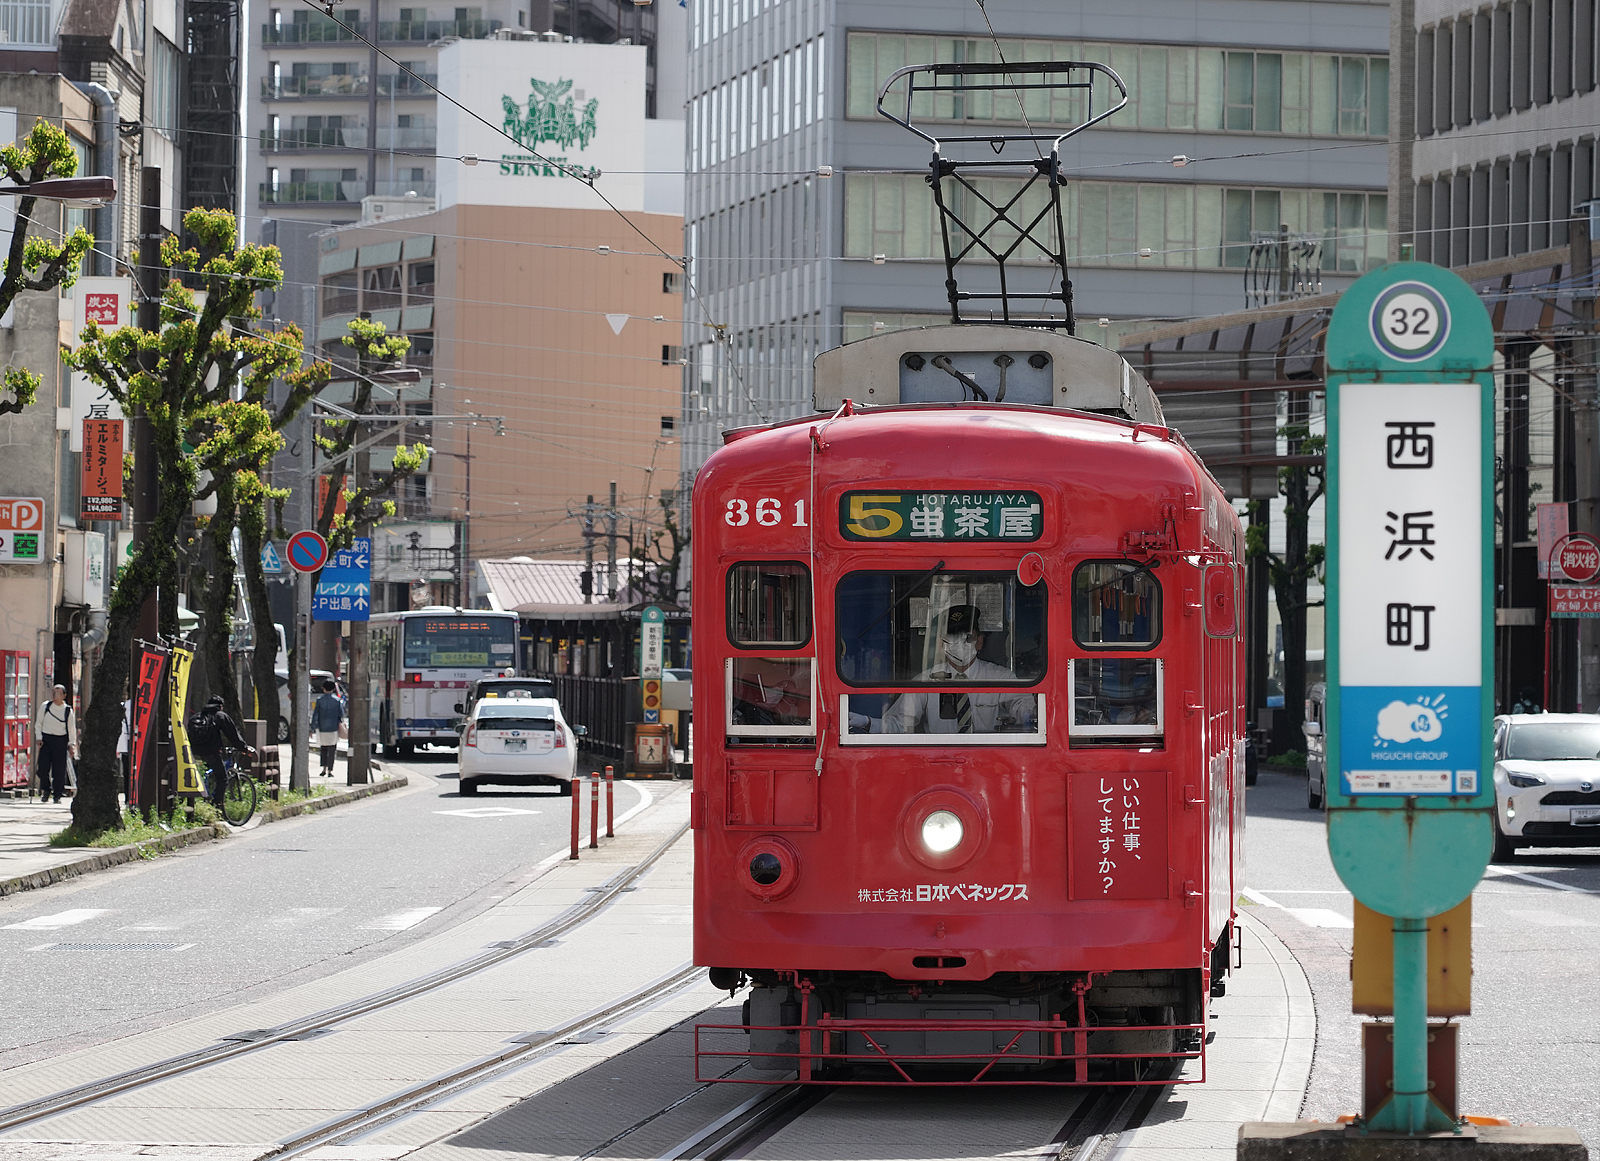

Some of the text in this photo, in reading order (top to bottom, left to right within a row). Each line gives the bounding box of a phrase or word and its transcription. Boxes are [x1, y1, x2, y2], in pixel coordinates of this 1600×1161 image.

[87, 296, 117, 309] 炭火
[1390, 308, 1430, 336] 32
[97, 423, 108, 495] エルミタージュ
[724, 497, 809, 527] 361
[916, 494, 1028, 506] HOTARUJAYA
[11, 501, 39, 529] P
[846, 494, 904, 538] 5
[910, 506, 1035, 538] 蛍茶屋
[1385, 421, 1436, 651] 西浜町
[1563, 552, 1597, 569] 消火栓
[316, 582, 351, 595] レイン
[1371, 752, 1449, 761] HIGUCHI GROUP
[1122, 778, 1142, 860] いい仕事、
[1097, 778, 1117, 894] してますか?
